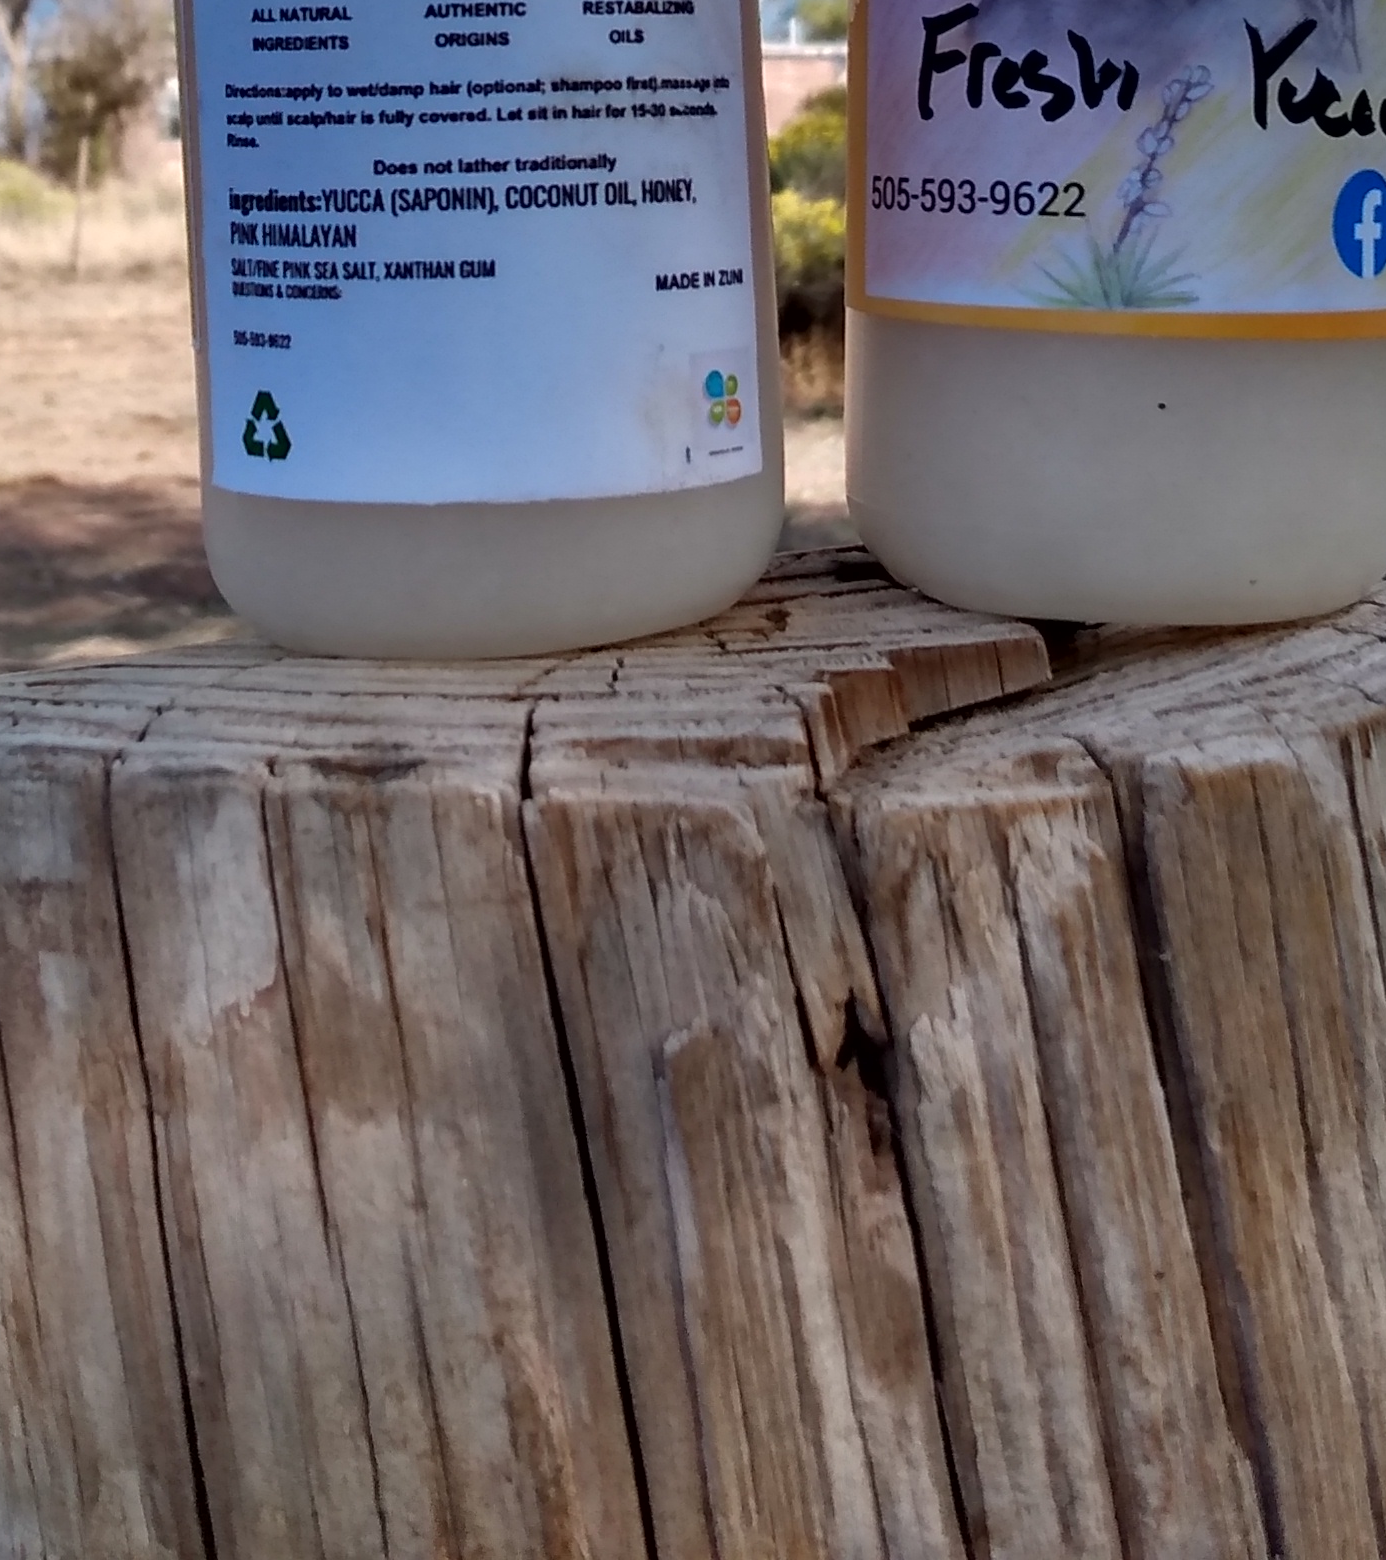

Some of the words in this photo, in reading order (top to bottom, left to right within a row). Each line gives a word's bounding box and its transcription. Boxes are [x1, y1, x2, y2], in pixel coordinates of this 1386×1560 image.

[251, 7, 277, 23] ALL
[279, 5, 353, 22] NATURAL
[424, 2, 527, 19] AUTHENTIC
[582, 0, 695, 16] RESTABALIZING
[251, 35, 349, 52] INGREDIENTS
[434, 31, 511, 49] ORIGINS
[609, 28, 645, 45] OILS
[916, 3, 1140, 121] Fresh
[327, 84, 343, 97] to
[429, 80, 461, 95] hair
[550, 78, 623, 94] shampoo
[226, 111, 254, 128] scalp
[256, 111, 283, 125] until
[361, 110, 374, 124] is
[379, 109, 414, 128] fully
[419, 108, 491, 124] covered.
[496, 107, 523, 122] Let
[527, 104, 548, 121] sit
[552, 105, 567, 119] in
[572, 105, 601, 120] hair
[605, 103, 626, 119] for
[631, 103, 666, 117] 15-30
[373, 159, 417, 175] Does
[423, 160, 452, 174] not
[458, 158, 509, 173] lather
[515, 153, 617, 172] traditionally
[391, 187, 498, 216] (SAPONIN),
[506, 182, 599, 210] COCONUT
[605, 182, 637, 206] OIL,
[641, 178, 697, 204] HONEY,
[871, 175, 1086, 218] 505-593-9622
[230, 221, 259, 246] PINK
[262, 224, 357, 248] HIMALAYAN
[283, 260, 311, 280] PINK
[314, 261, 339, 280] SEA
[342, 261, 380, 282] SALT,
[383, 260, 454, 280] XANTHAN
[459, 259, 495, 278] GUM
[655, 271, 700, 291] MADE
[703, 270, 715, 287] IN
[718, 268, 743, 286] ZUNI
